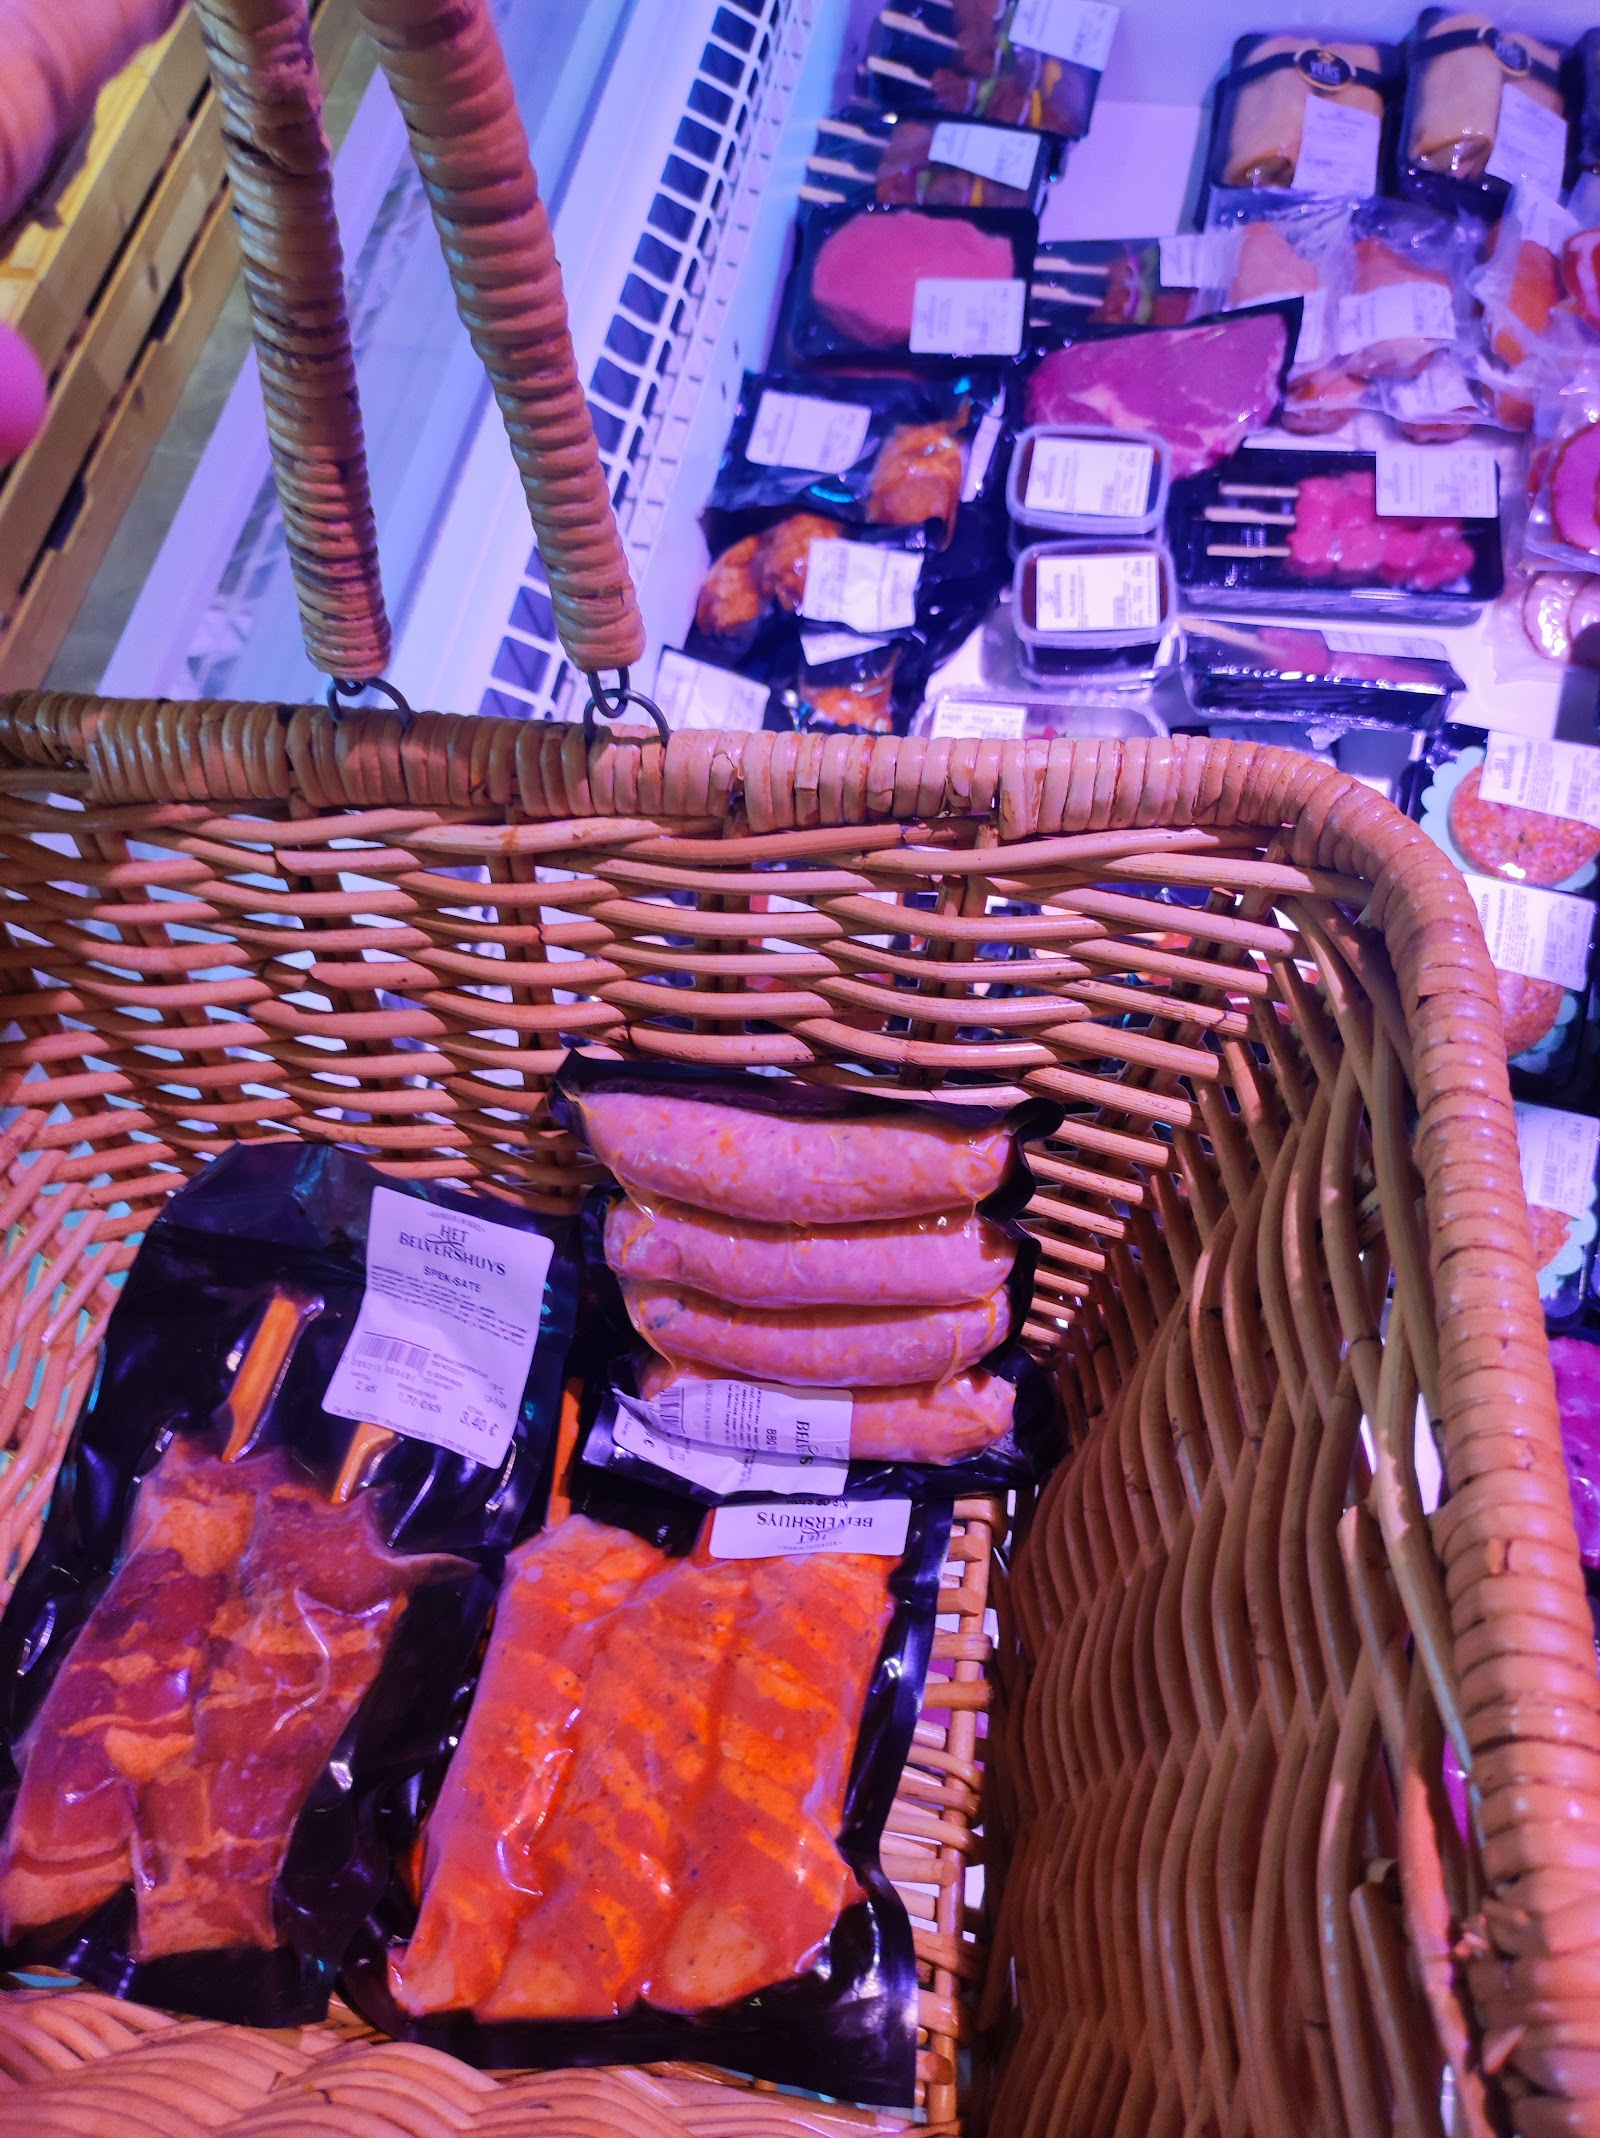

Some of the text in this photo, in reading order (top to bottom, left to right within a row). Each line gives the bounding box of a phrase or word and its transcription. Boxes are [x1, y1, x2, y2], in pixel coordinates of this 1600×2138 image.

[440, 1223, 470, 1244] HET
[399, 1231, 507, 1277] BELVERSHUYS
[423, 1265, 482, 1294] SPEK-SATE
